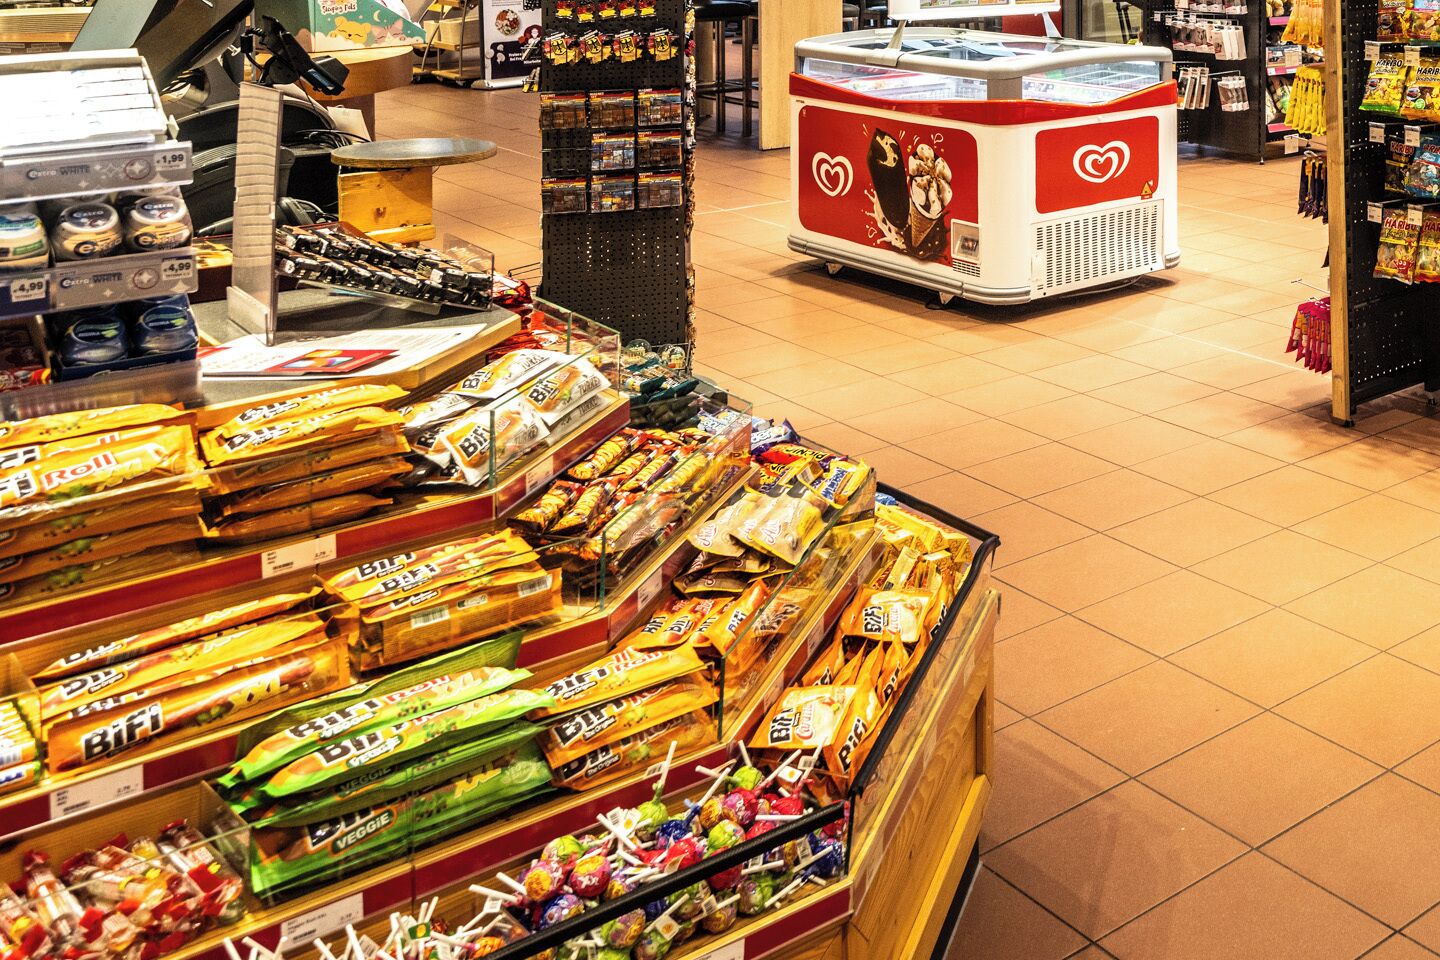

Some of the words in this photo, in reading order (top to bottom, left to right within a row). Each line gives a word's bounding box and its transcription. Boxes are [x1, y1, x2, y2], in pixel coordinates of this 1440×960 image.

[1375, 59, 1403, 68] HARIBO
[42, 451, 118, 489] Roll
[863, 605, 884, 634] BiFi
[81, 701, 163, 761] BiFi
[769, 707, 794, 745] BiFi
